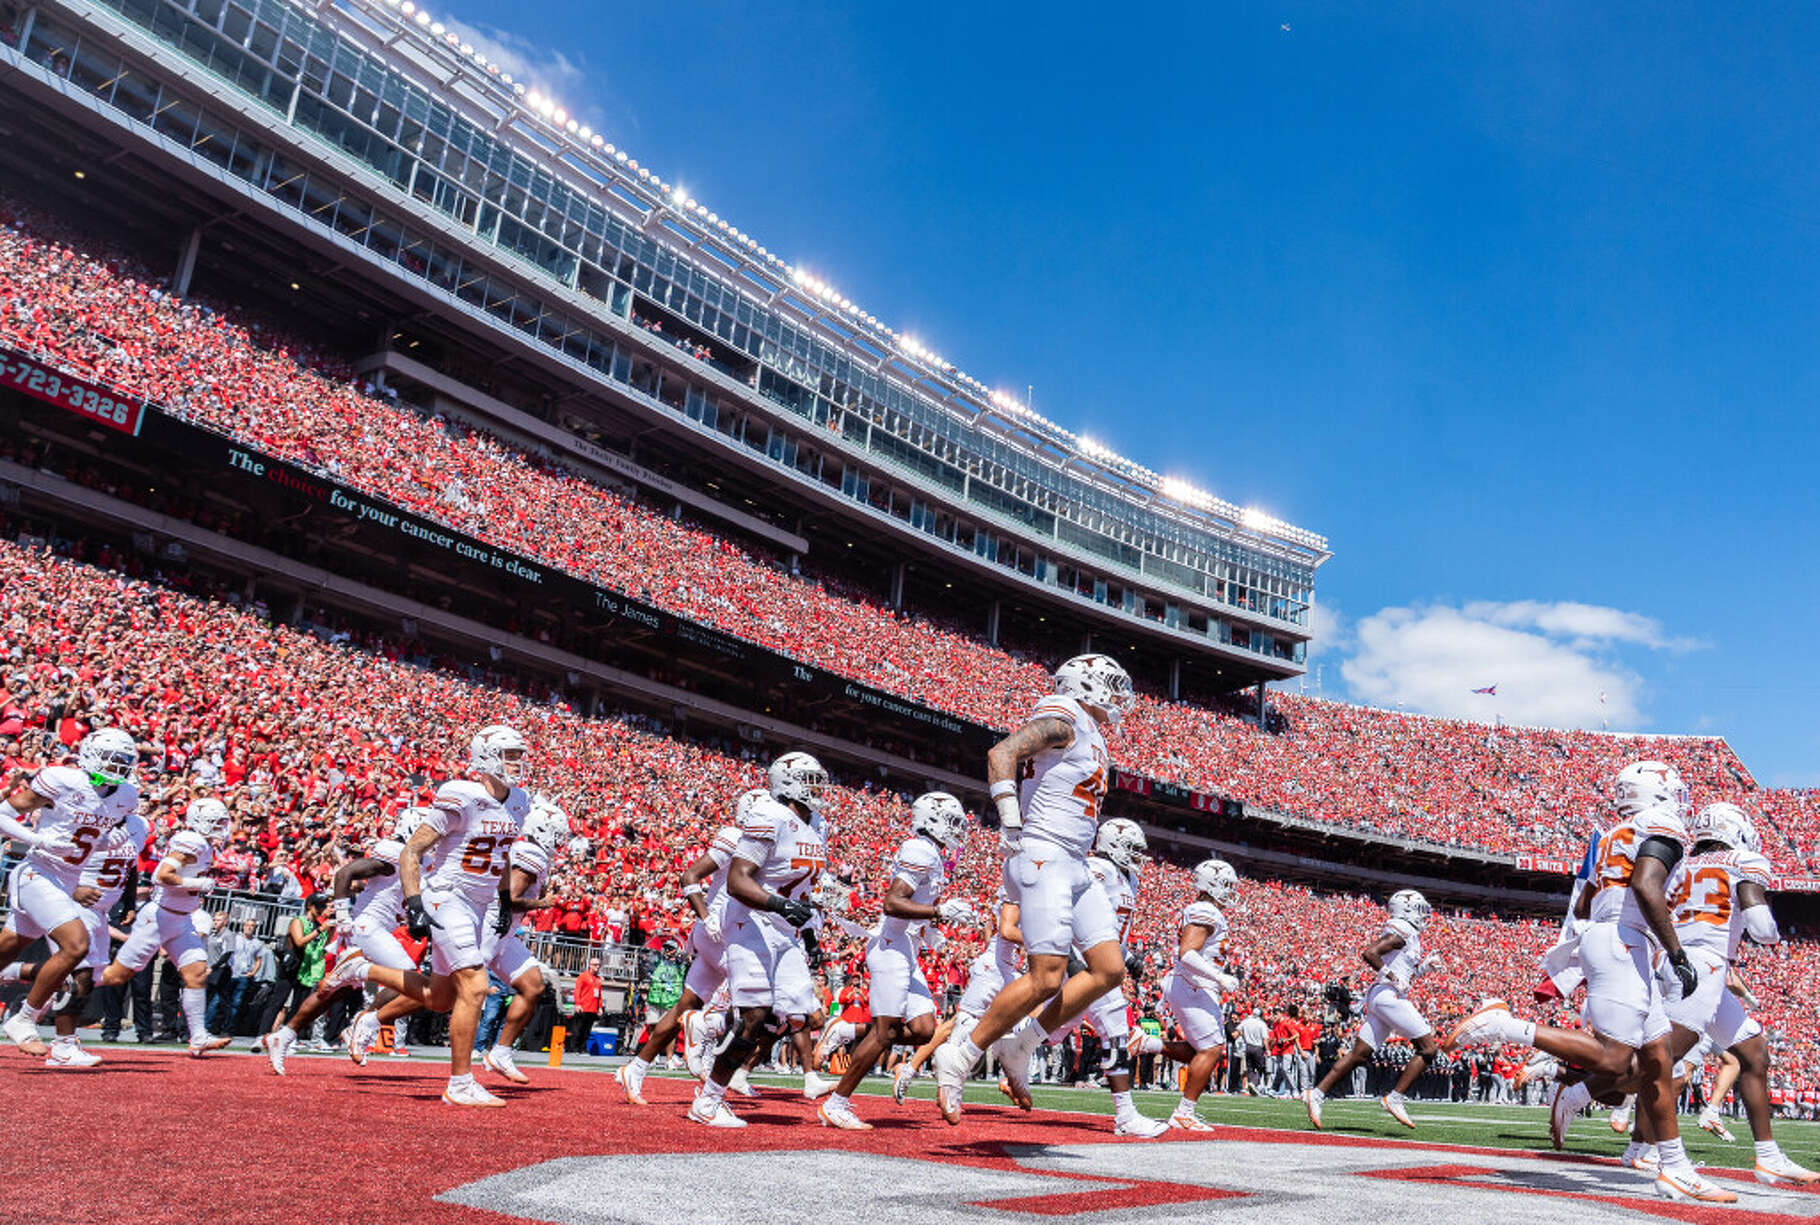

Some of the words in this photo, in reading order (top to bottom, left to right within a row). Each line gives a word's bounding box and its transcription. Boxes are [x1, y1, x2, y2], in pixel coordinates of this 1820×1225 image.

[228, 449, 265, 476] The
[268, 467, 328, 498] choice
[330, 489, 357, 512] for
[358, 503, 399, 528] your
[401, 519, 454, 549] cancer
[456, 541, 488, 563] care
[490, 551, 504, 568] is
[505, 560, 543, 584] clear.
[595, 592, 617, 612] The
[620, 604, 659, 629] James
[793, 665, 812, 682] The
[845, 684, 859, 697] for
[860, 692, 882, 705] your
[882, 700, 913, 716] cancer
[913, 710, 932, 722] care
[481, 820, 520, 836] TEXAS
